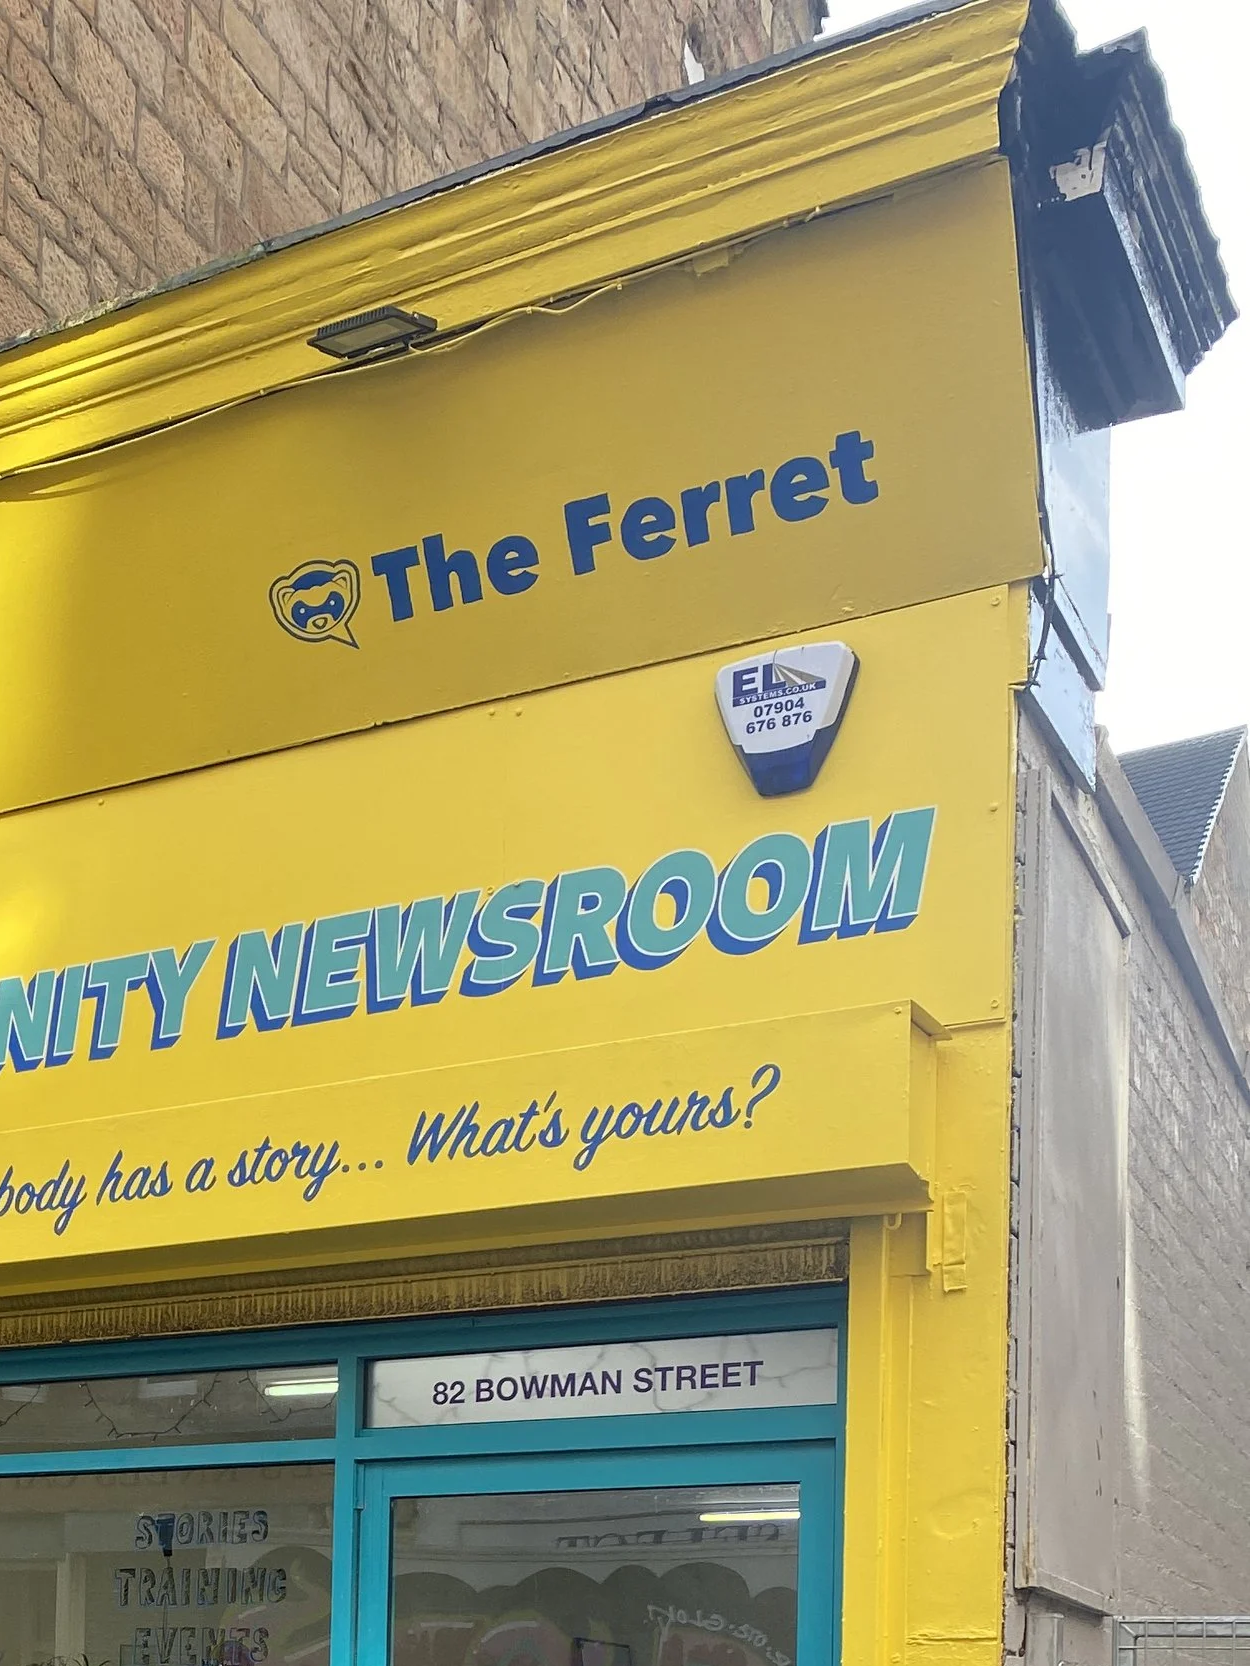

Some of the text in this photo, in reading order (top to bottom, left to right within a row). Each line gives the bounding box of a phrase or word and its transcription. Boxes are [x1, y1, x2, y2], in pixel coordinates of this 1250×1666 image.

[371, 430, 879, 622] The Ferret
[733, 663, 787, 697] EL
[739, 682, 816, 704] SYSTEMS.CO.UK
[746, 711, 812, 734] 676 876
[754, 697, 804, 718] 07904
[216, 806, 937, 1040] NEWSROOM
[96, 1150, 173, 1208] has
[185, 1157, 217, 1196] a
[227, 1136, 384, 1202] story...
[407, 1090, 570, 1167] What's
[577, 1063, 781, 1172] yours?
[432, 1360, 765, 1406] 82 BOWMAN STREET
[135, 1511, 269, 1549] STORIES
[115, 1568, 287, 1607] TRAINING
[133, 1627, 270, 1666] EVENTS
